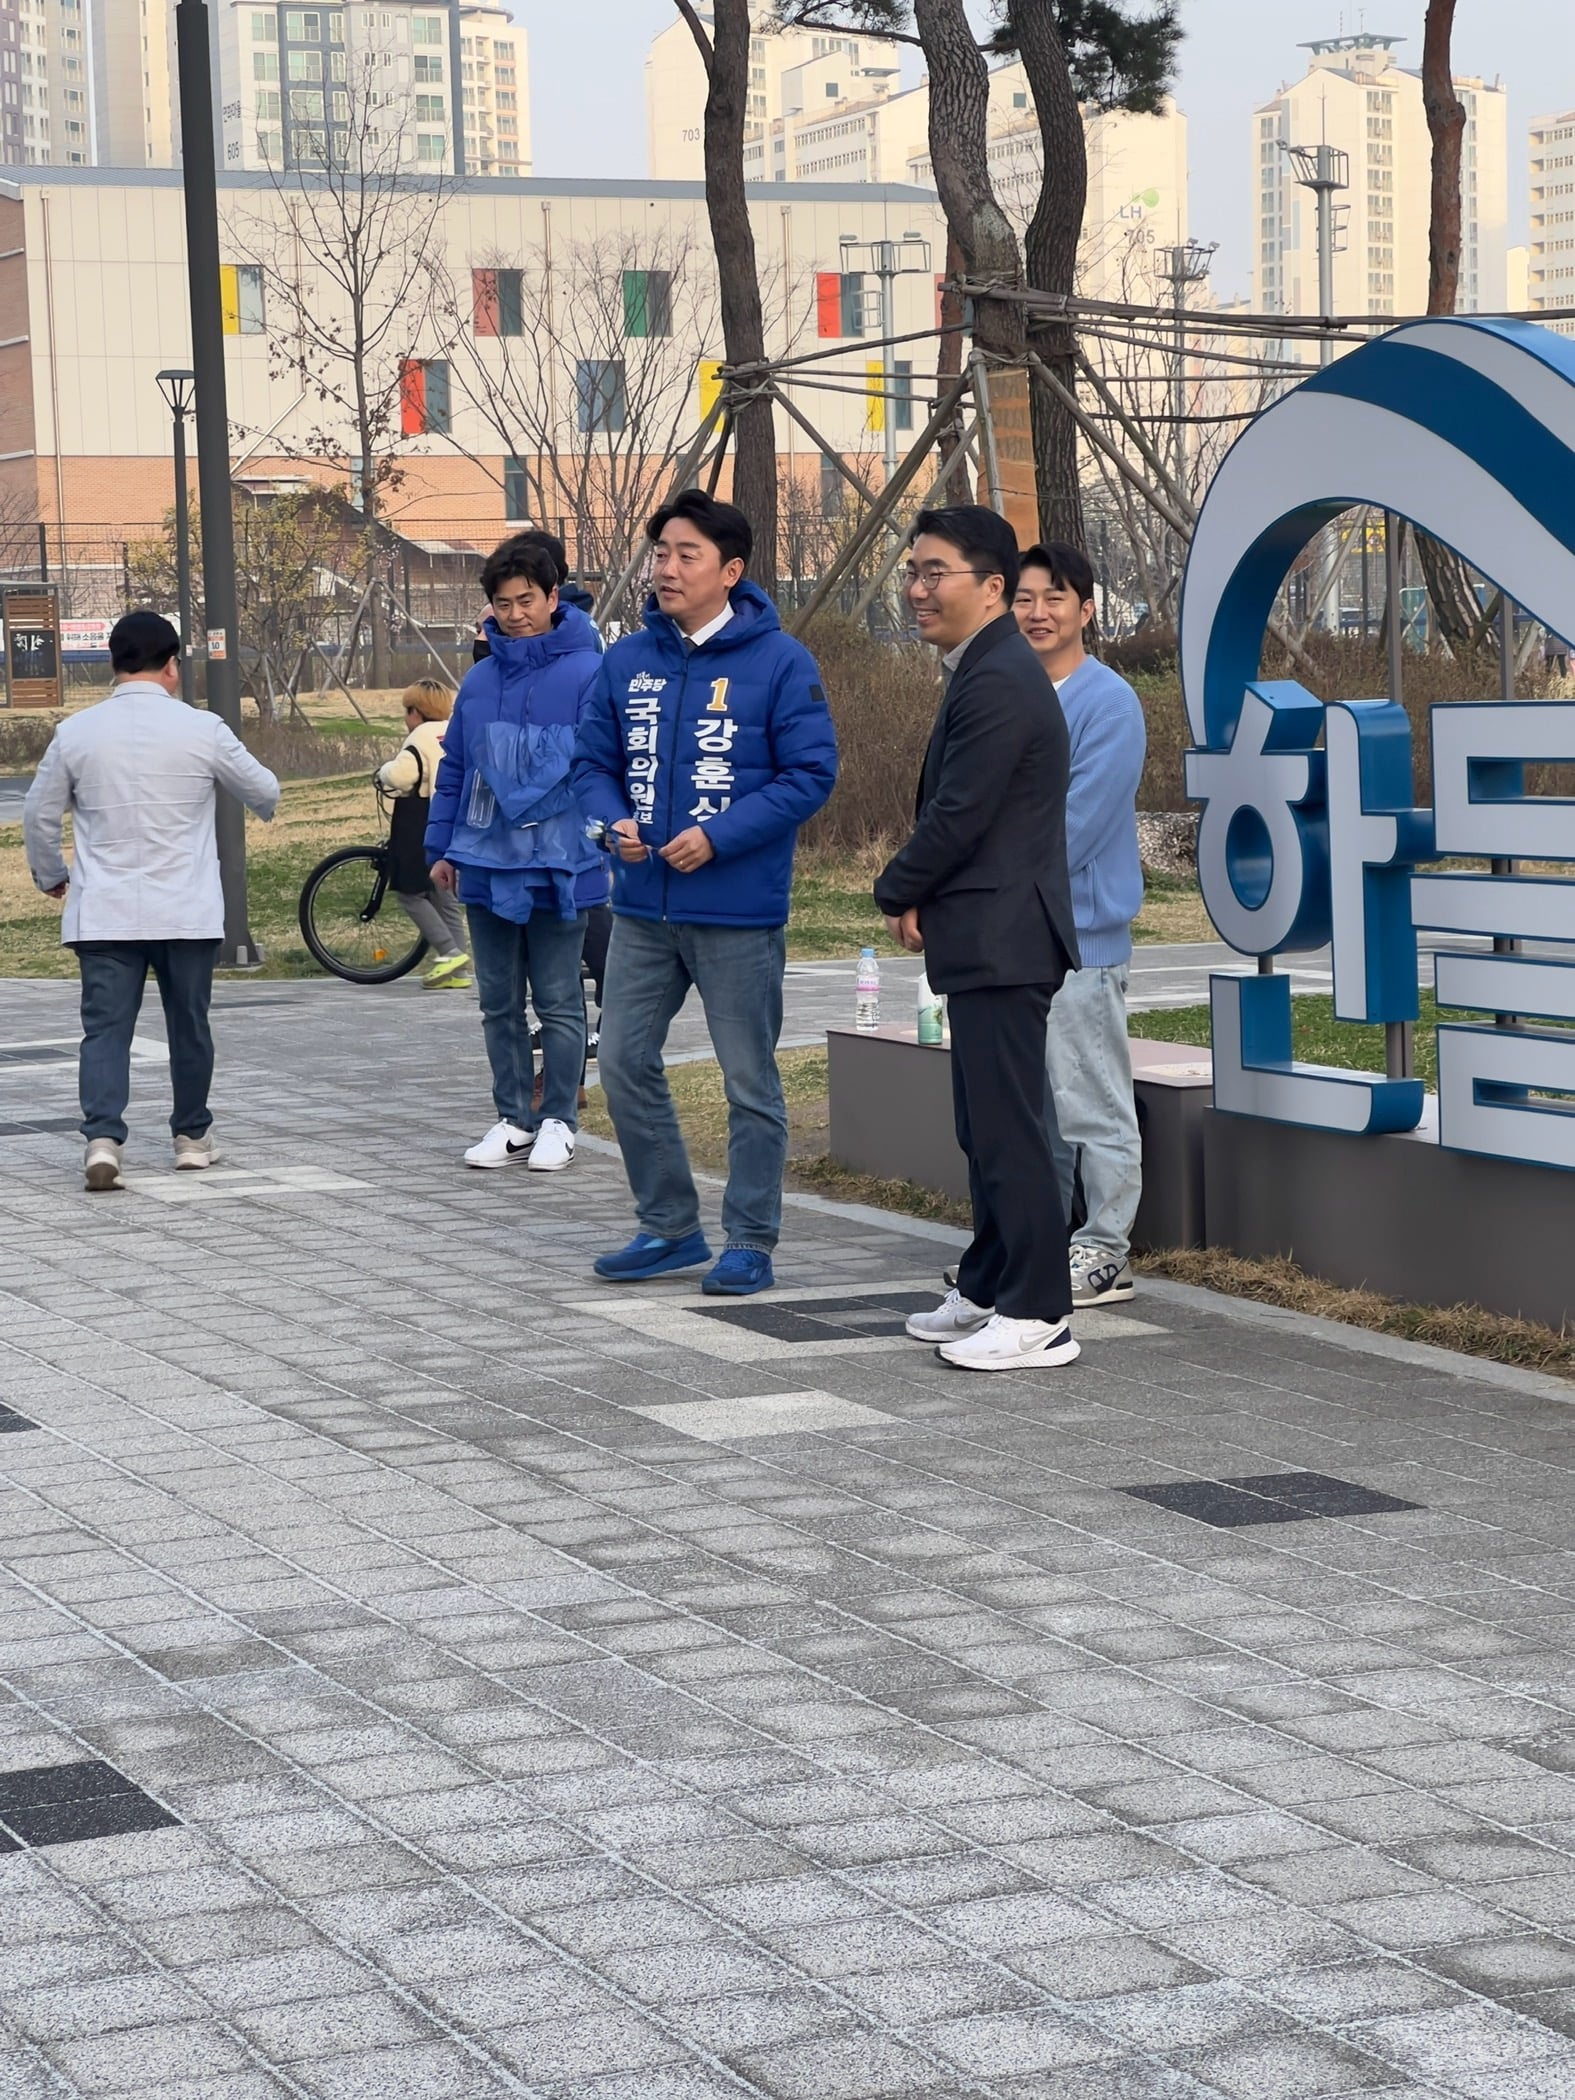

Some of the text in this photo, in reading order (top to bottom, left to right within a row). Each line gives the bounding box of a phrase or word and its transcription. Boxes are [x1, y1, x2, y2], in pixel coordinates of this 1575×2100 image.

[682, 128, 700, 142] 703
[227, 141, 239, 160] 605
[1120, 206, 1141, 218] LH
[1127, 229, 1156, 244] 705
[628, 678, 667, 693] 민주당
[706, 677, 729, 711] 1
[625, 697, 661, 811] 국회의원
